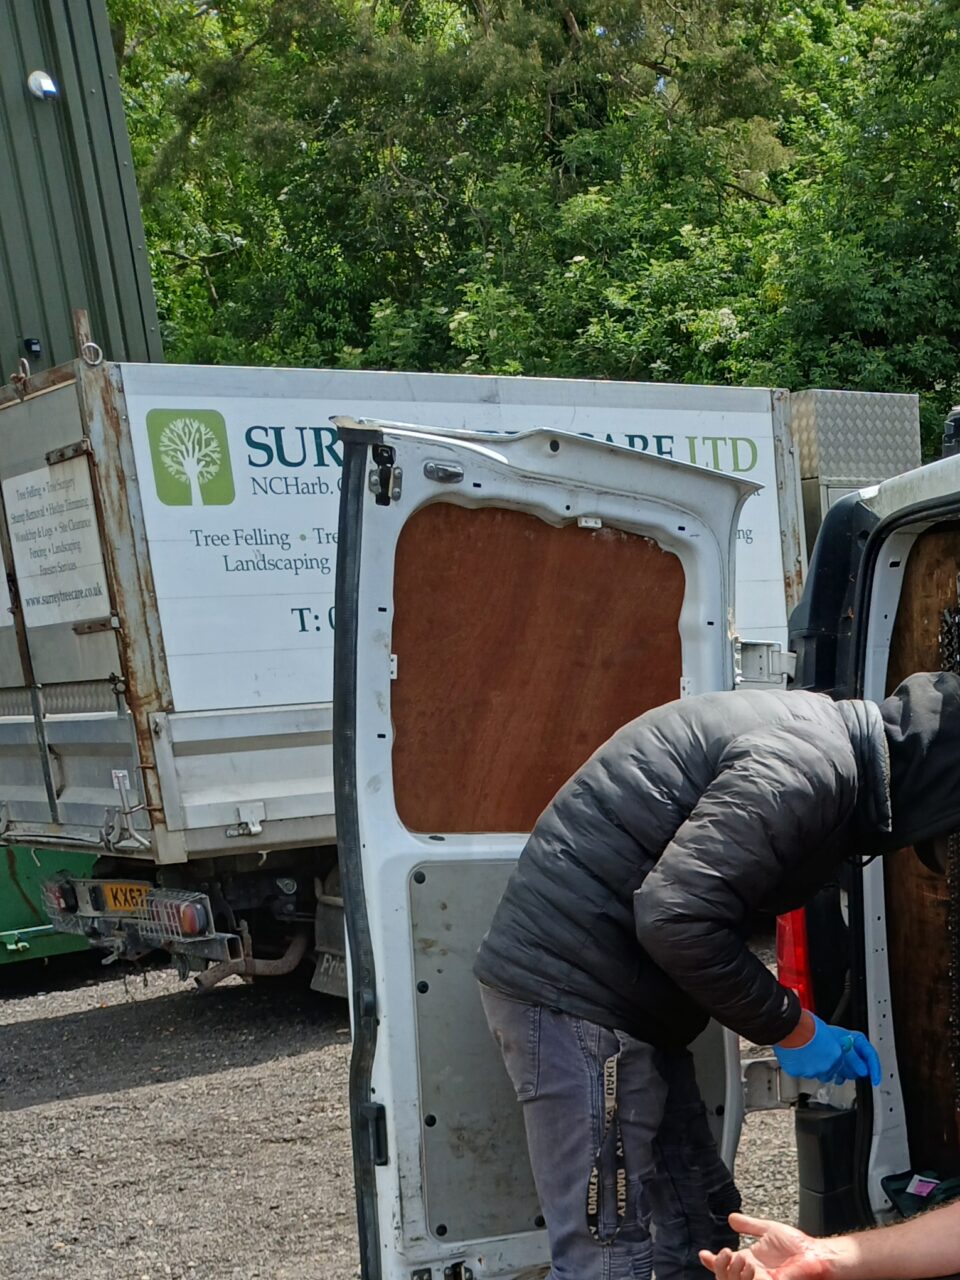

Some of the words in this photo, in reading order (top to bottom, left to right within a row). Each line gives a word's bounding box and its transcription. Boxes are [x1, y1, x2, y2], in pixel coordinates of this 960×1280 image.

[250, 475, 334, 495] NCHarb.
[190, 529, 230, 547] Tree
[233, 528, 291, 551] Felling
[223, 553, 331, 576] Landscaping
[291, 607, 321, 632] T:
[588, 1167, 599, 1215] OAKLEY
[616, 1168, 626, 1217] OAKLEY
